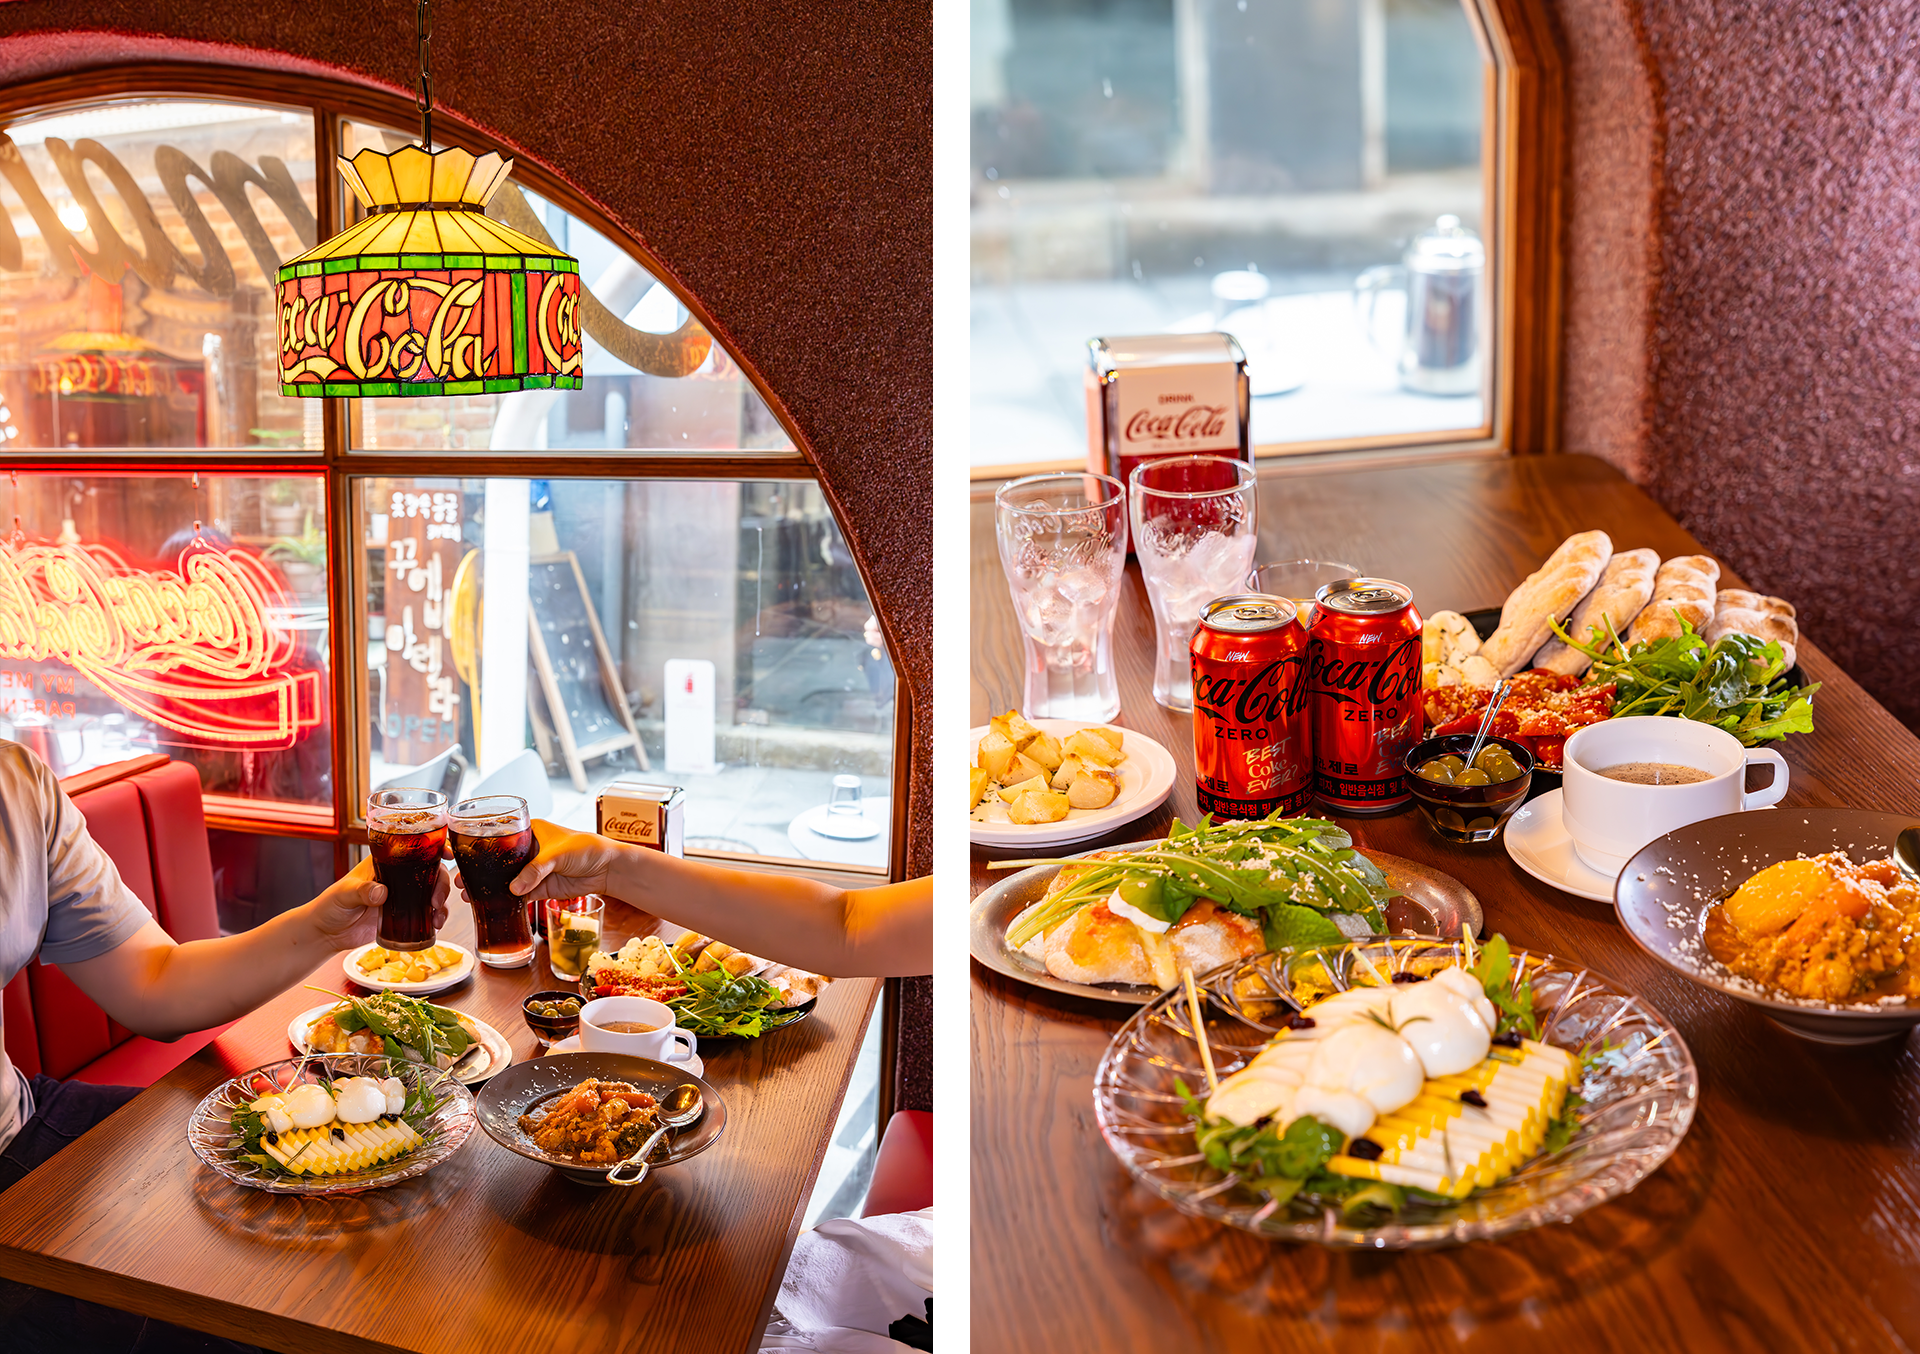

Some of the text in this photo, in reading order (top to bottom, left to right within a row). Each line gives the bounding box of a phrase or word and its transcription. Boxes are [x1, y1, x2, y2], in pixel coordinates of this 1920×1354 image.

[1358, 632, 1383, 645] NEW
[1225, 650, 1250, 662] NEW
[1309, 635, 1424, 706] oca-Col
[1344, 708, 1398, 722] ZERO
[386, 713, 456, 744] OPEN
[1215, 726, 1269, 740] ZERO
[1373, 714, 1415, 745] BEST
[1242, 736, 1292, 765] BEST
[1248, 759, 1288, 778] Coke
[1328, 760, 1359, 776] 제로
[1374, 752, 1406, 775] EVE
[1204, 775, 1230, 794] 제로
[1245, 764, 1299, 795] EVER?
[1339, 782, 1386, 798] 일반음식점
[1389, 780, 1398, 794] 및
[1213, 799, 1258, 817] 일반음식점
[1261, 802, 1272, 816] 및
[604, 816, 654, 837] Coca-Cola
